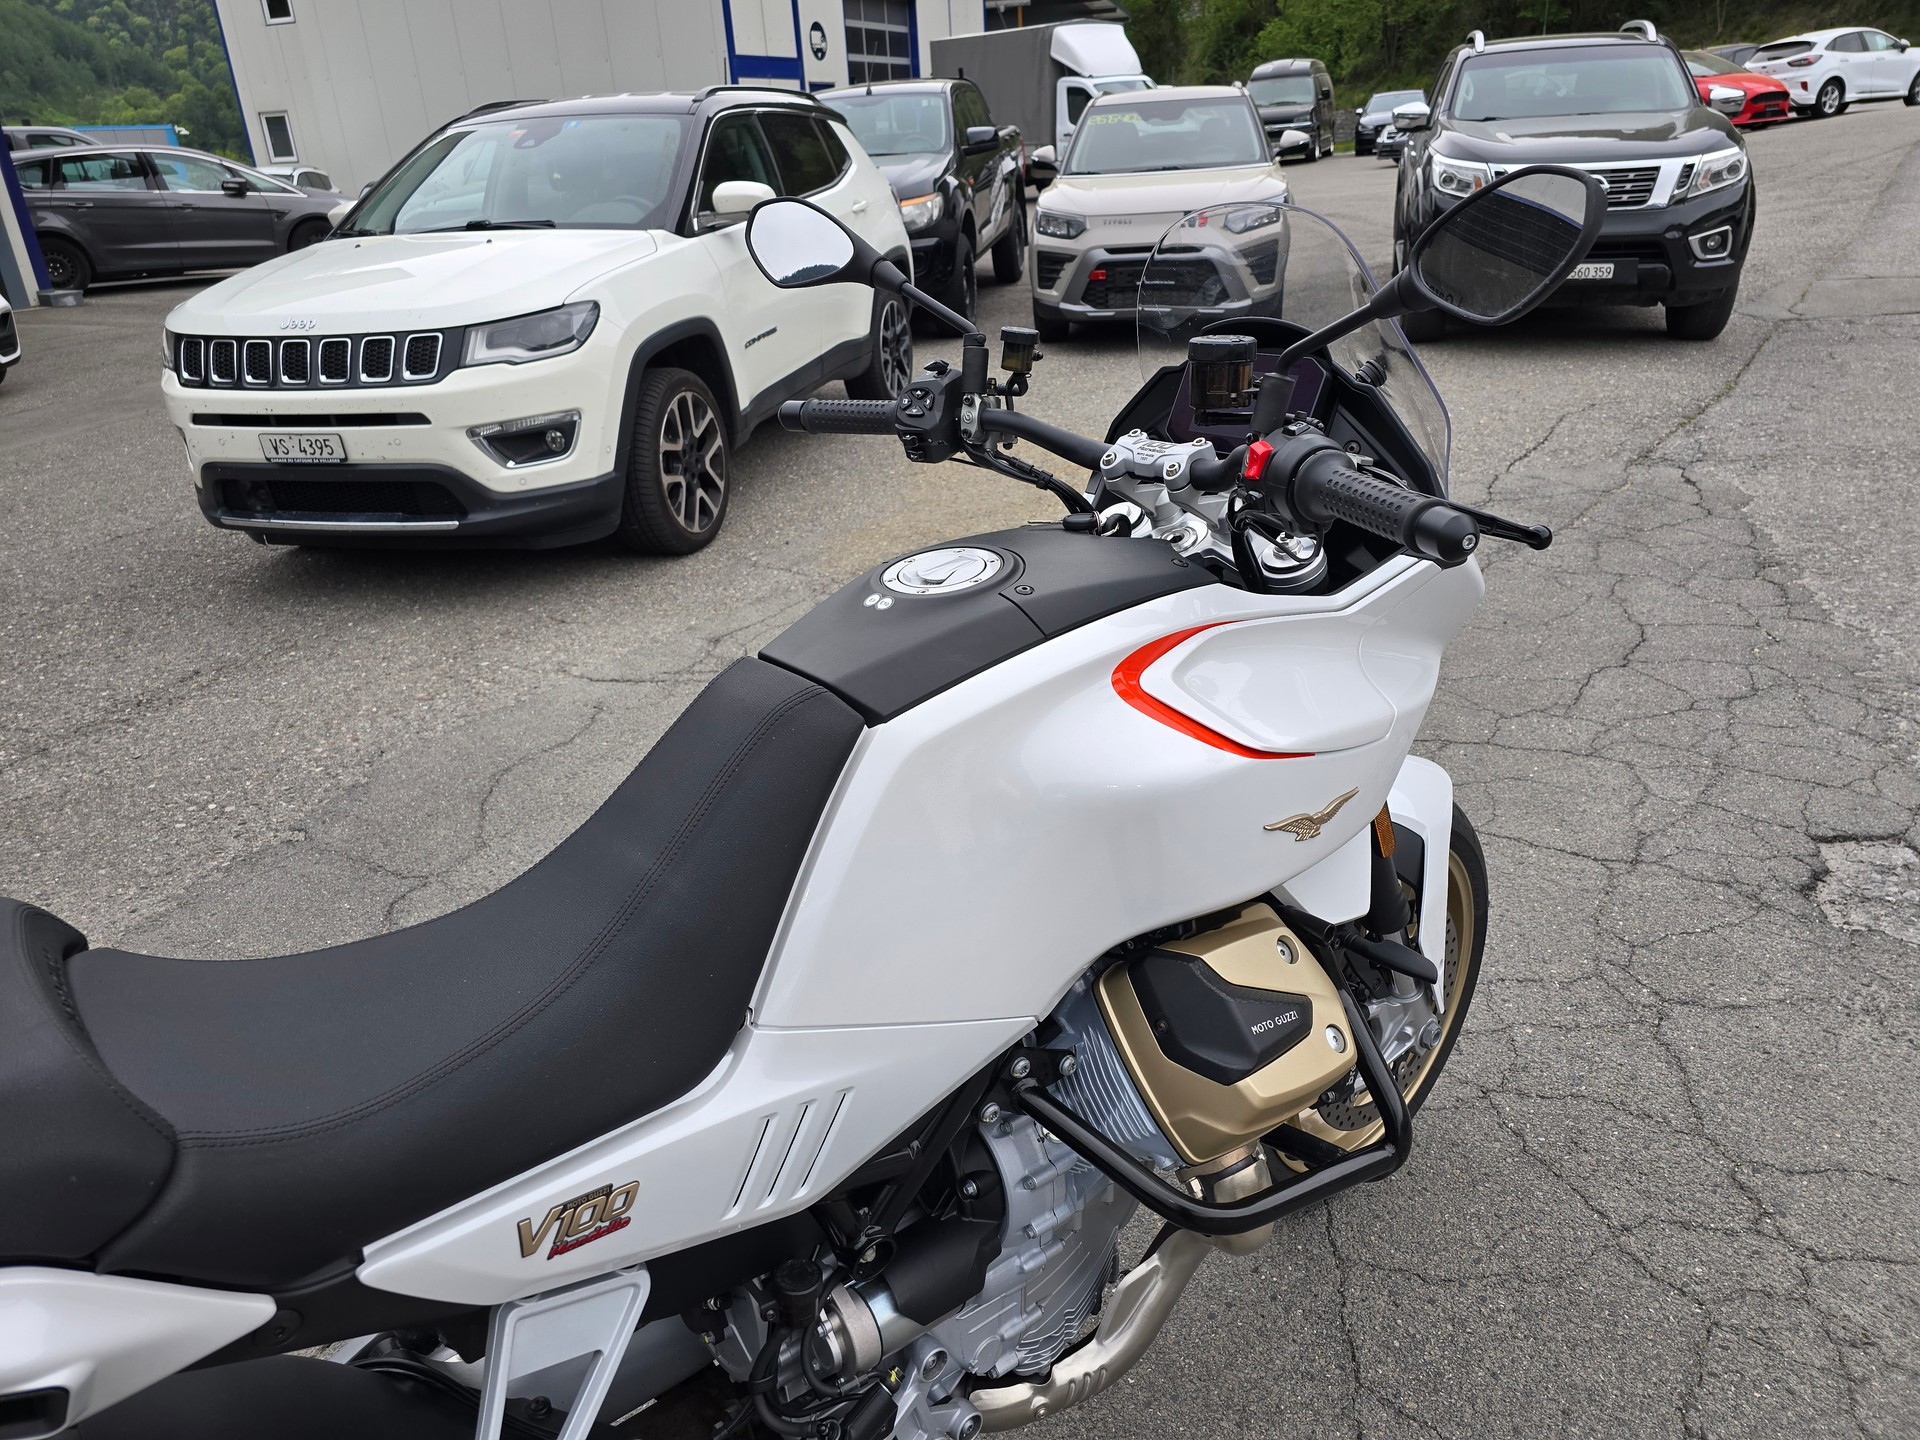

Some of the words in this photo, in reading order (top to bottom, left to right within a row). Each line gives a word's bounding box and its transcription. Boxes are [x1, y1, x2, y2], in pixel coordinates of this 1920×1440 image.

[1592, 266, 1612, 278] 359
[280, 315, 316, 331] Jeep
[269, 438, 290, 456] VS
[299, 438, 334, 456] 4395
[1251, 1019, 1275, 1035] MOTO
[1274, 1010, 1299, 1026] GUZZI
[566, 1197, 588, 1210] MOTO
[588, 1187, 611, 1201] GUZZI
[517, 1180, 640, 1258] V100
